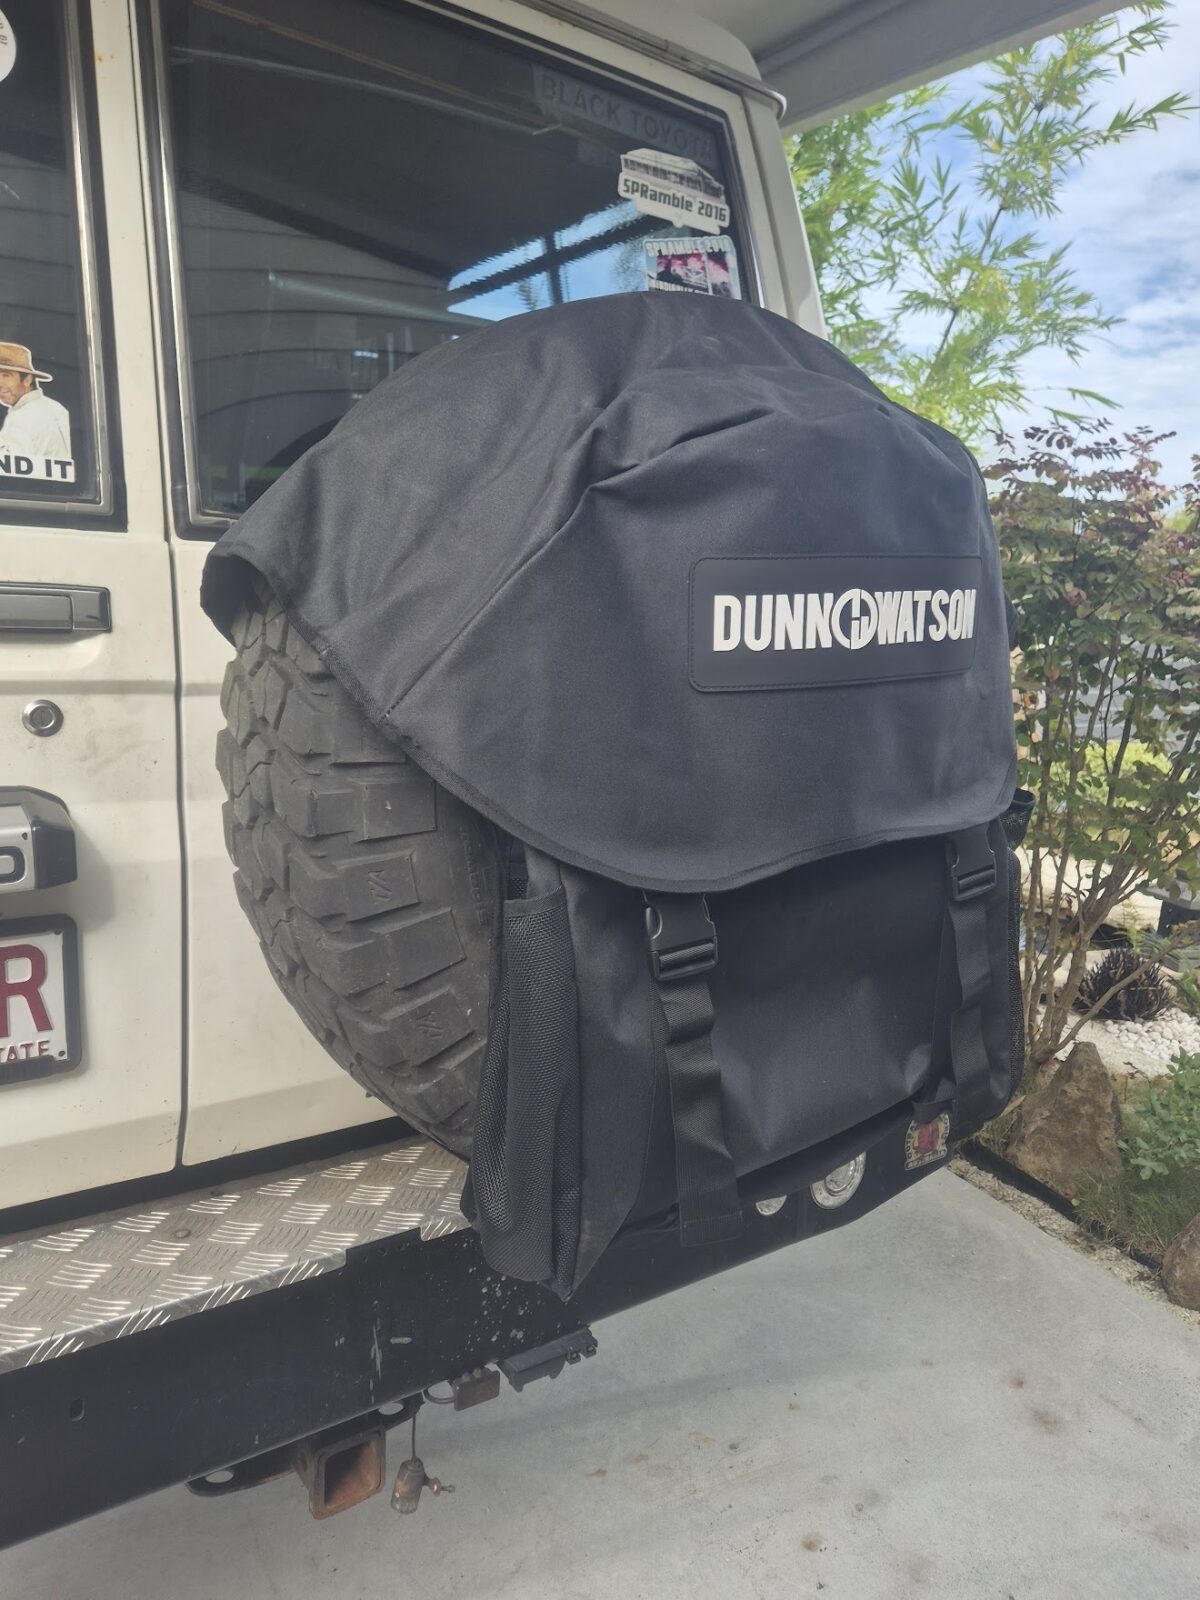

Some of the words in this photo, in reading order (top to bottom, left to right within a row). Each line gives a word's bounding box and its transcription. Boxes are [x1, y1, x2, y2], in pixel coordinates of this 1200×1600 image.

[541, 74, 620, 125] BLACK
[698, 201, 727, 222] 2016
[45, 458, 73, 479] IT
